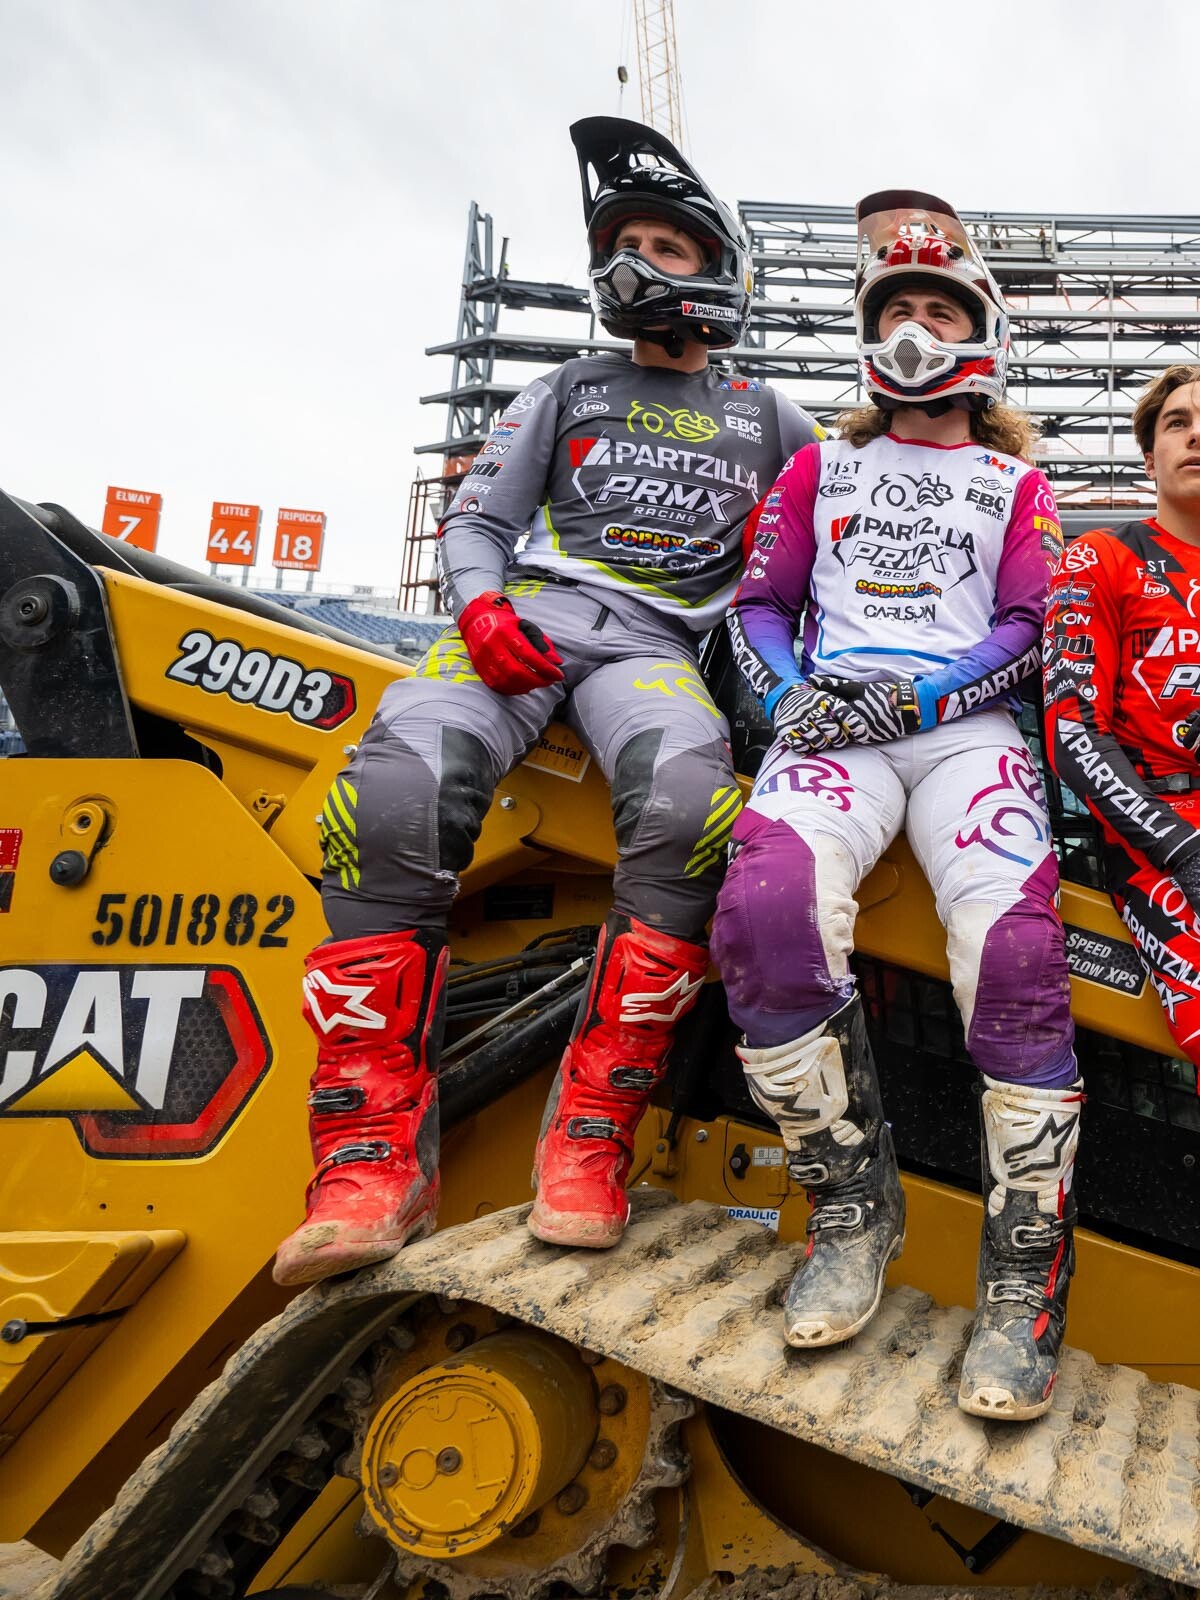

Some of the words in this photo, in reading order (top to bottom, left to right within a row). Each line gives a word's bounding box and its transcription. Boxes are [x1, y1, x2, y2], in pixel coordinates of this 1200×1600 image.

[720, 381, 760, 391] AMA
[725, 415, 762, 437] EBC
[738, 431, 762, 444] BRAKES
[616, 441, 759, 494] PARTZILLA
[975, 454, 1016, 475] AMA
[116, 490, 151, 505] ELWAY
[596, 474, 740, 524] PRMX
[965, 488, 1006, 512] EBC
[219, 505, 251, 517] LITTLE
[279, 510, 323, 524] TRIPUCKA
[633, 506, 697, 523] RACING
[117, 515, 142, 541] 7
[209, 528, 252, 555] 44
[280, 534, 313, 561] 18
[847, 541, 950, 574] PRMX
[873, 568, 920, 579] RACING
[1136, 560, 1166, 579] FST
[864, 604, 936, 622] CARLSON
[167, 632, 333, 721] 299D3
[963, 646, 1042, 710] PARTZI
[539, 739, 583, 760] Rental
[91, 893, 295, 948] 501882
[1066, 932, 1112, 959] SPEED
[1067, 954, 1105, 979] FLOW
[1103, 967, 1140, 989] XPS
[0, 968, 206, 1110] CAT
[728, 1208, 778, 1220] DRAULIC
